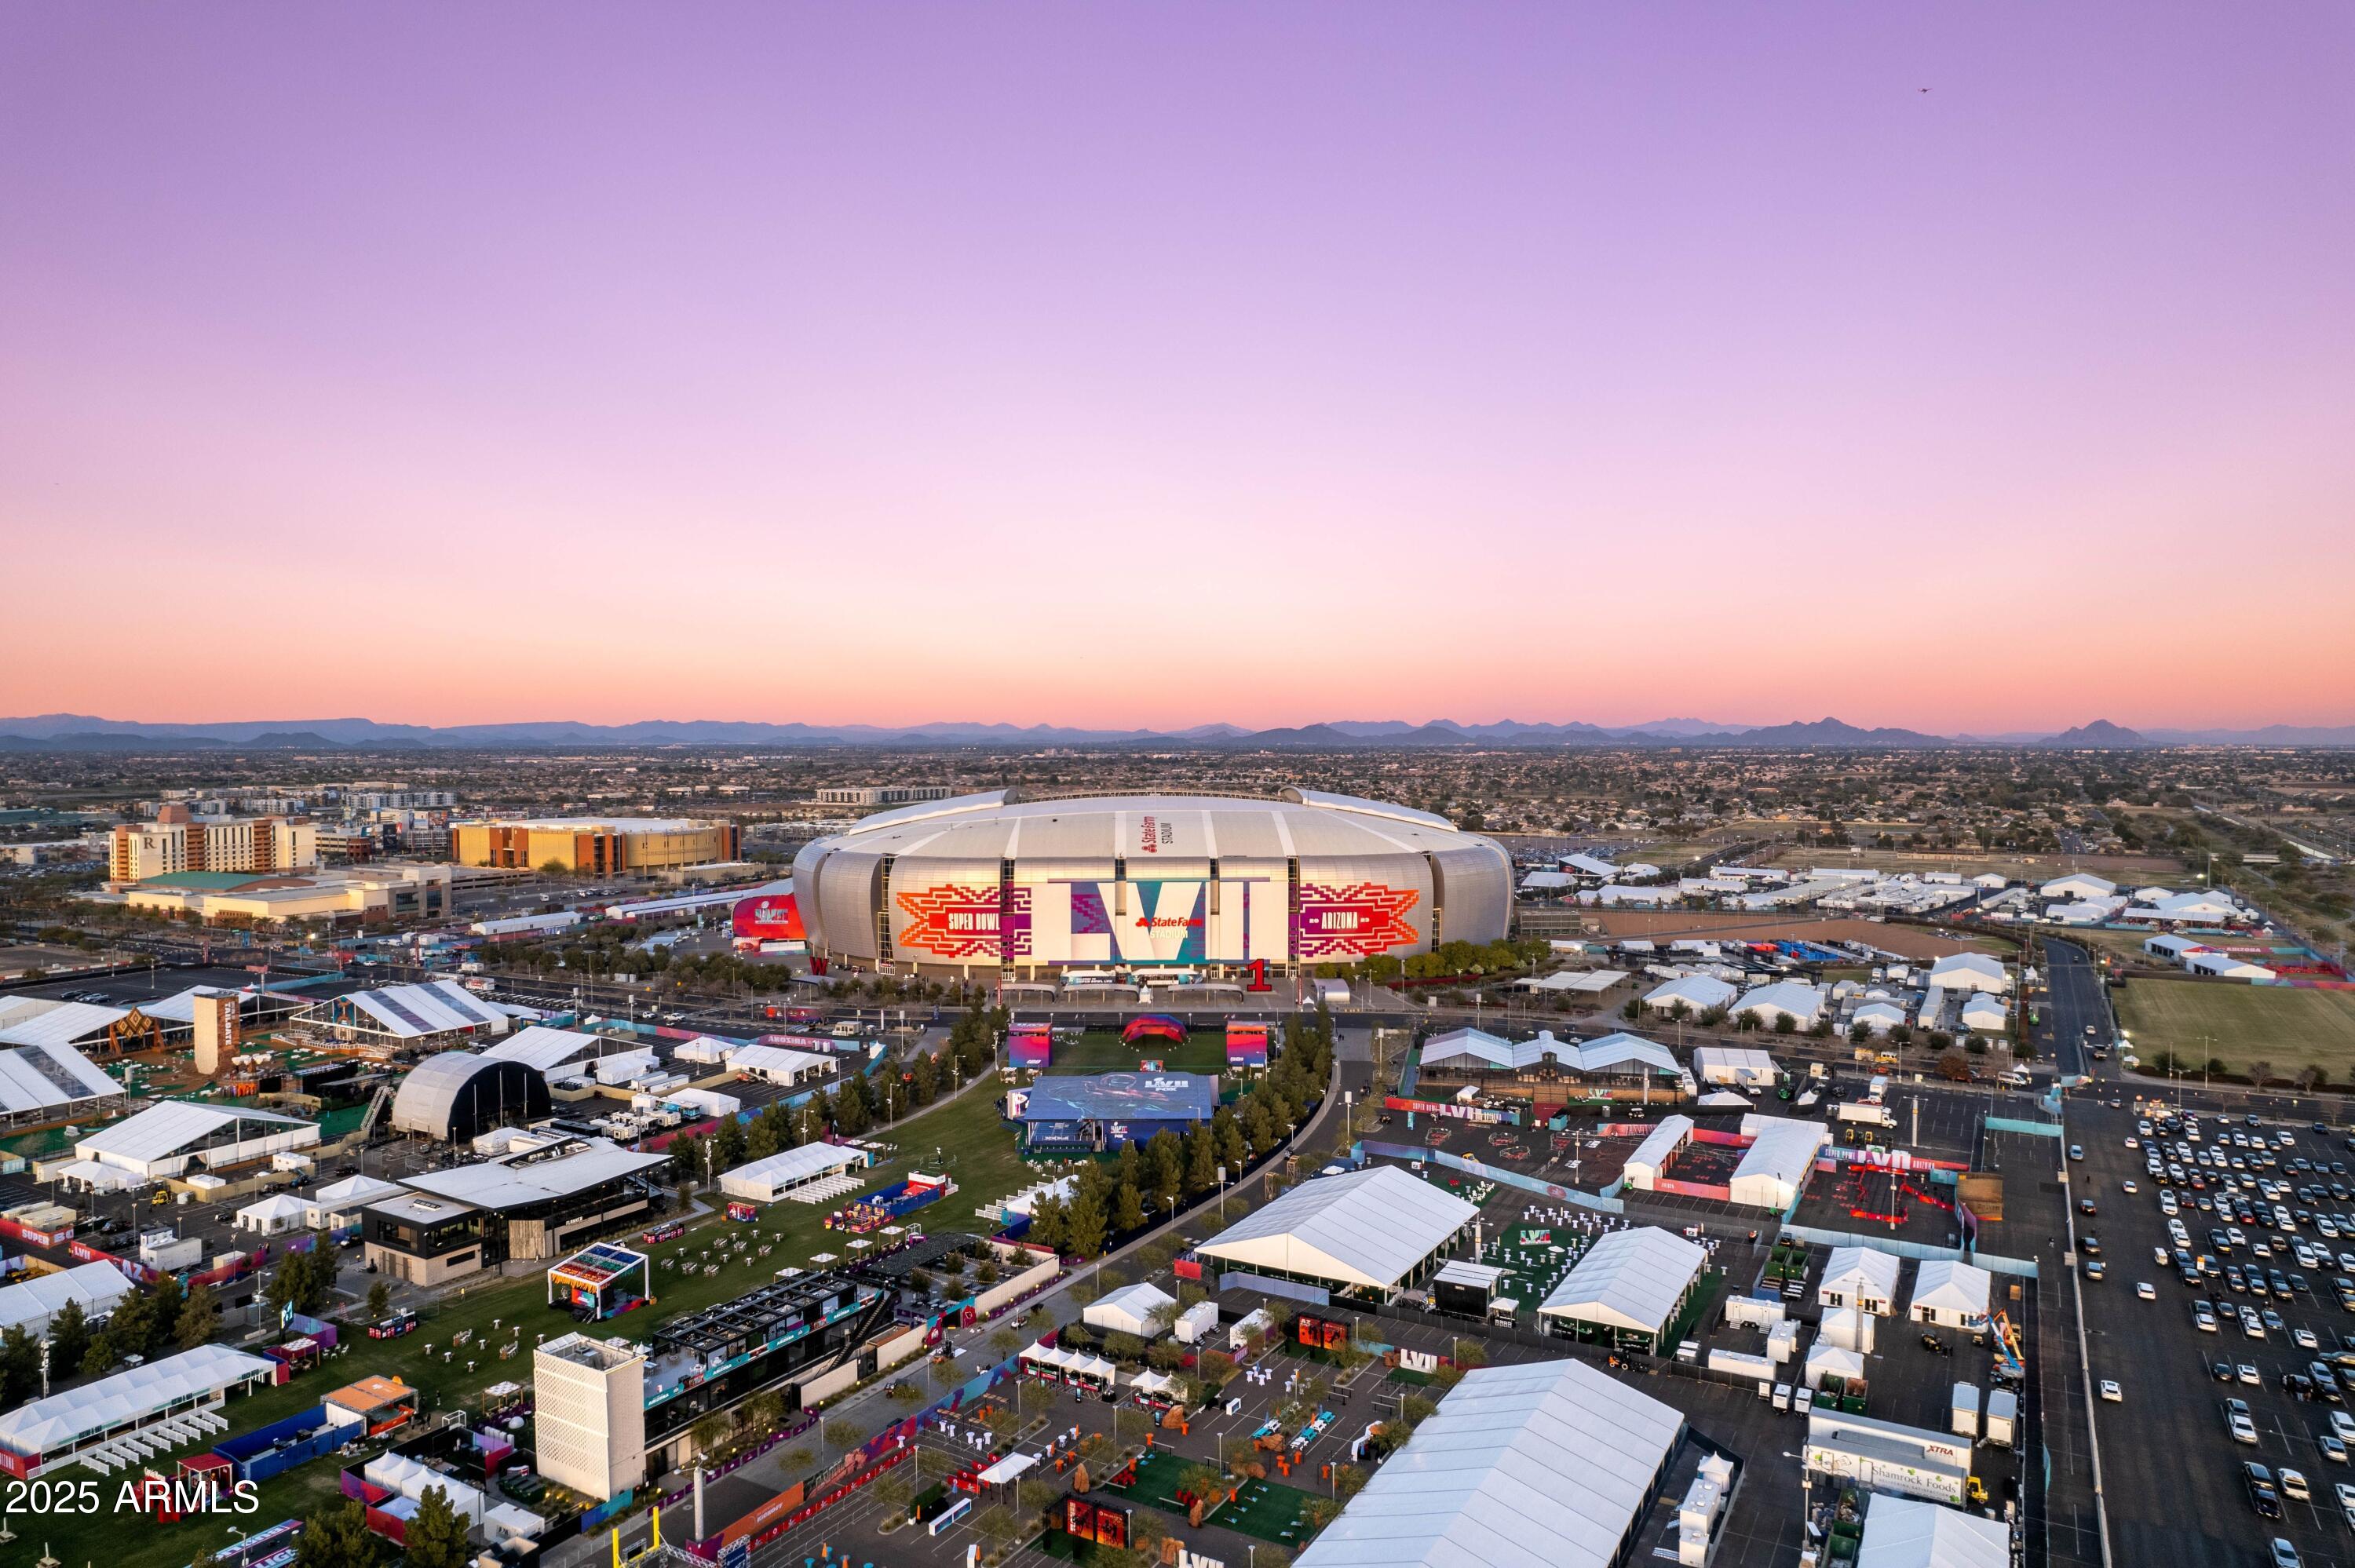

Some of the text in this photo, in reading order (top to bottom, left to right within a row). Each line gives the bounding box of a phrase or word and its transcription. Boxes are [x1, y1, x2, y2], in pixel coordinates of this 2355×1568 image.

[1161, 822, 1174, 844] STADIUM
[144, 837, 157, 849] R
[948, 912, 1000, 931] SUPER BOWL
[1321, 911, 1358, 930] ARIZONA
[1149, 928, 1188, 939] STADIUM
[809, 956, 828, 976] W
[1247, 958, 1272, 992] 1
[1824, 1148, 1841, 1158] SUPER
[1842, 1150, 1856, 1161] BOWL
[21, 1228, 49, 1246] SUPER
[1520, 1229, 1550, 1242] LVII
[73, 1245, 144, 1282] LVII AZ
[1400, 1348, 1438, 1370] LVII
[1926, 1444, 1954, 1457] XTRA
[1872, 1465, 1956, 1493] Shamrock Foods
